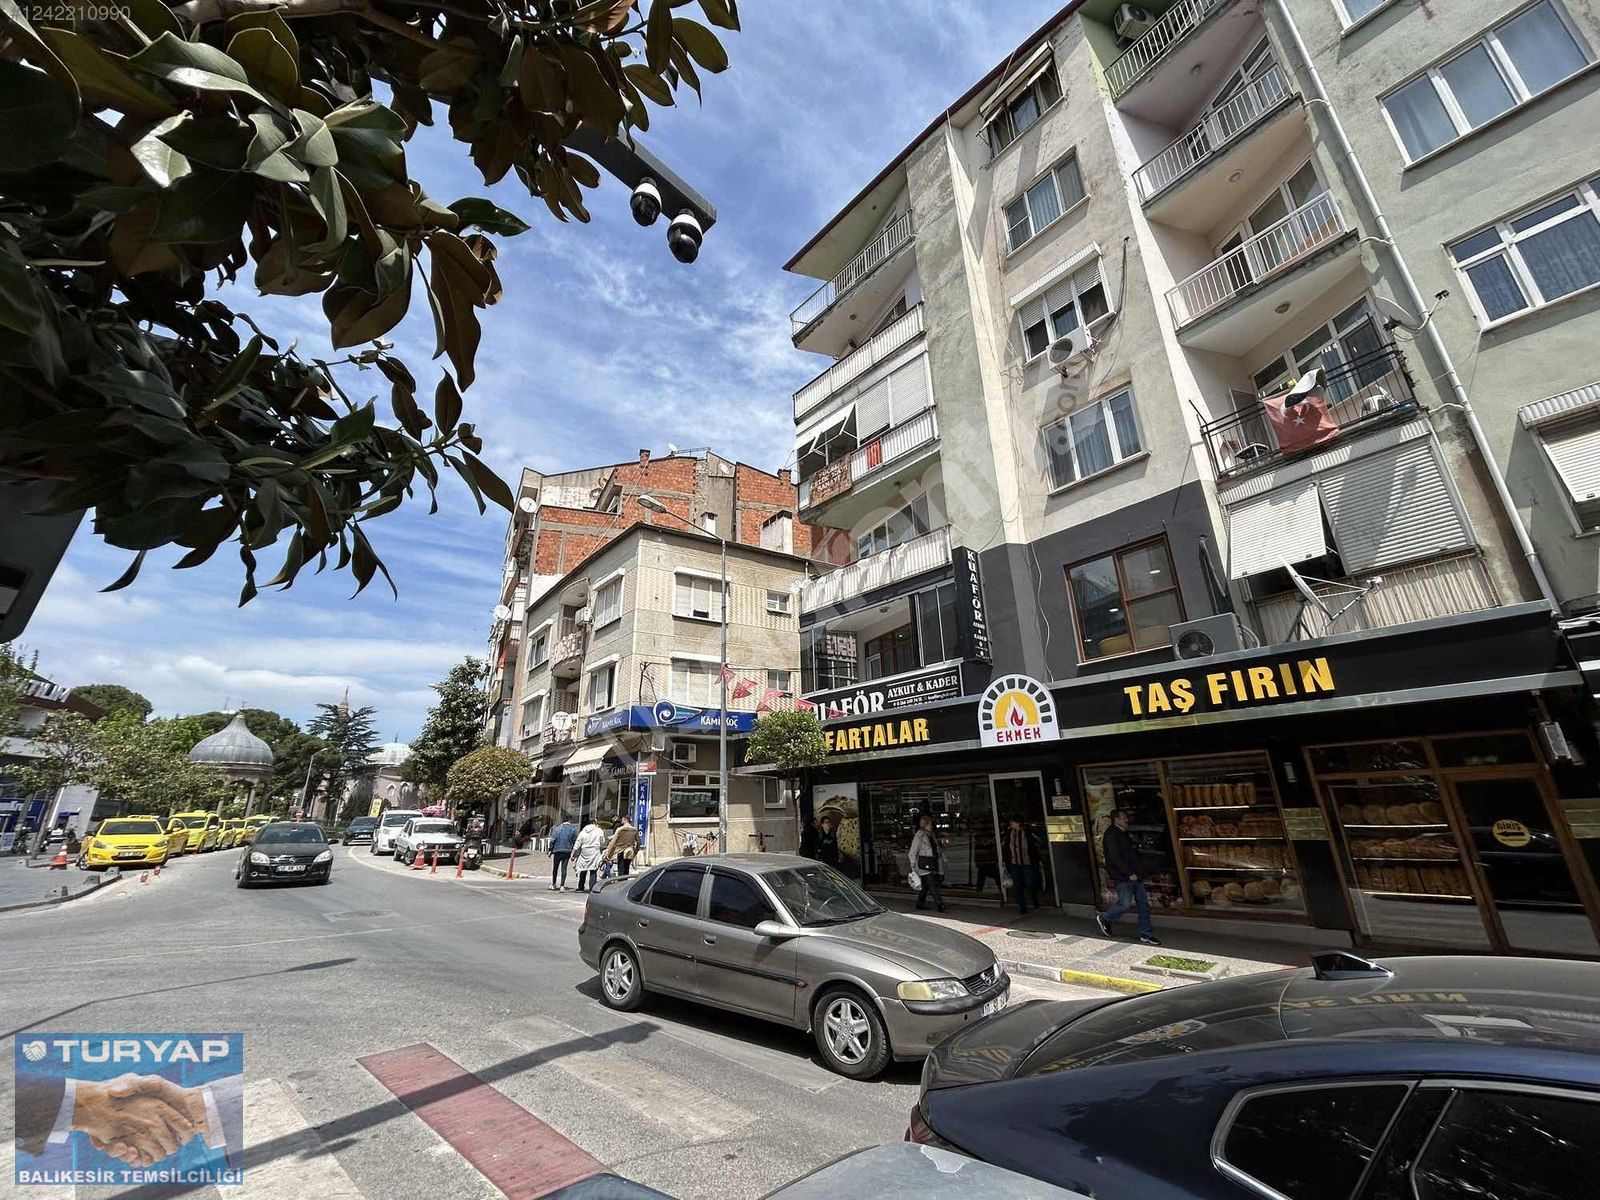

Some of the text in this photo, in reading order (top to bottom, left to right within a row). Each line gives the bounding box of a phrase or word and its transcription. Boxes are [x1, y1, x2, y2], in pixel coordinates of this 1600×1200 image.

[888, 684, 915, 698] AYKUT
[917, 682, 924, 692] &
[925, 675, 958, 691] KADER
[1124, 657, 1335, 714] TAŞ FIRIN
[700, 715, 721, 726] KÂMİ
[996, 727, 1042, 743] EKMEK
